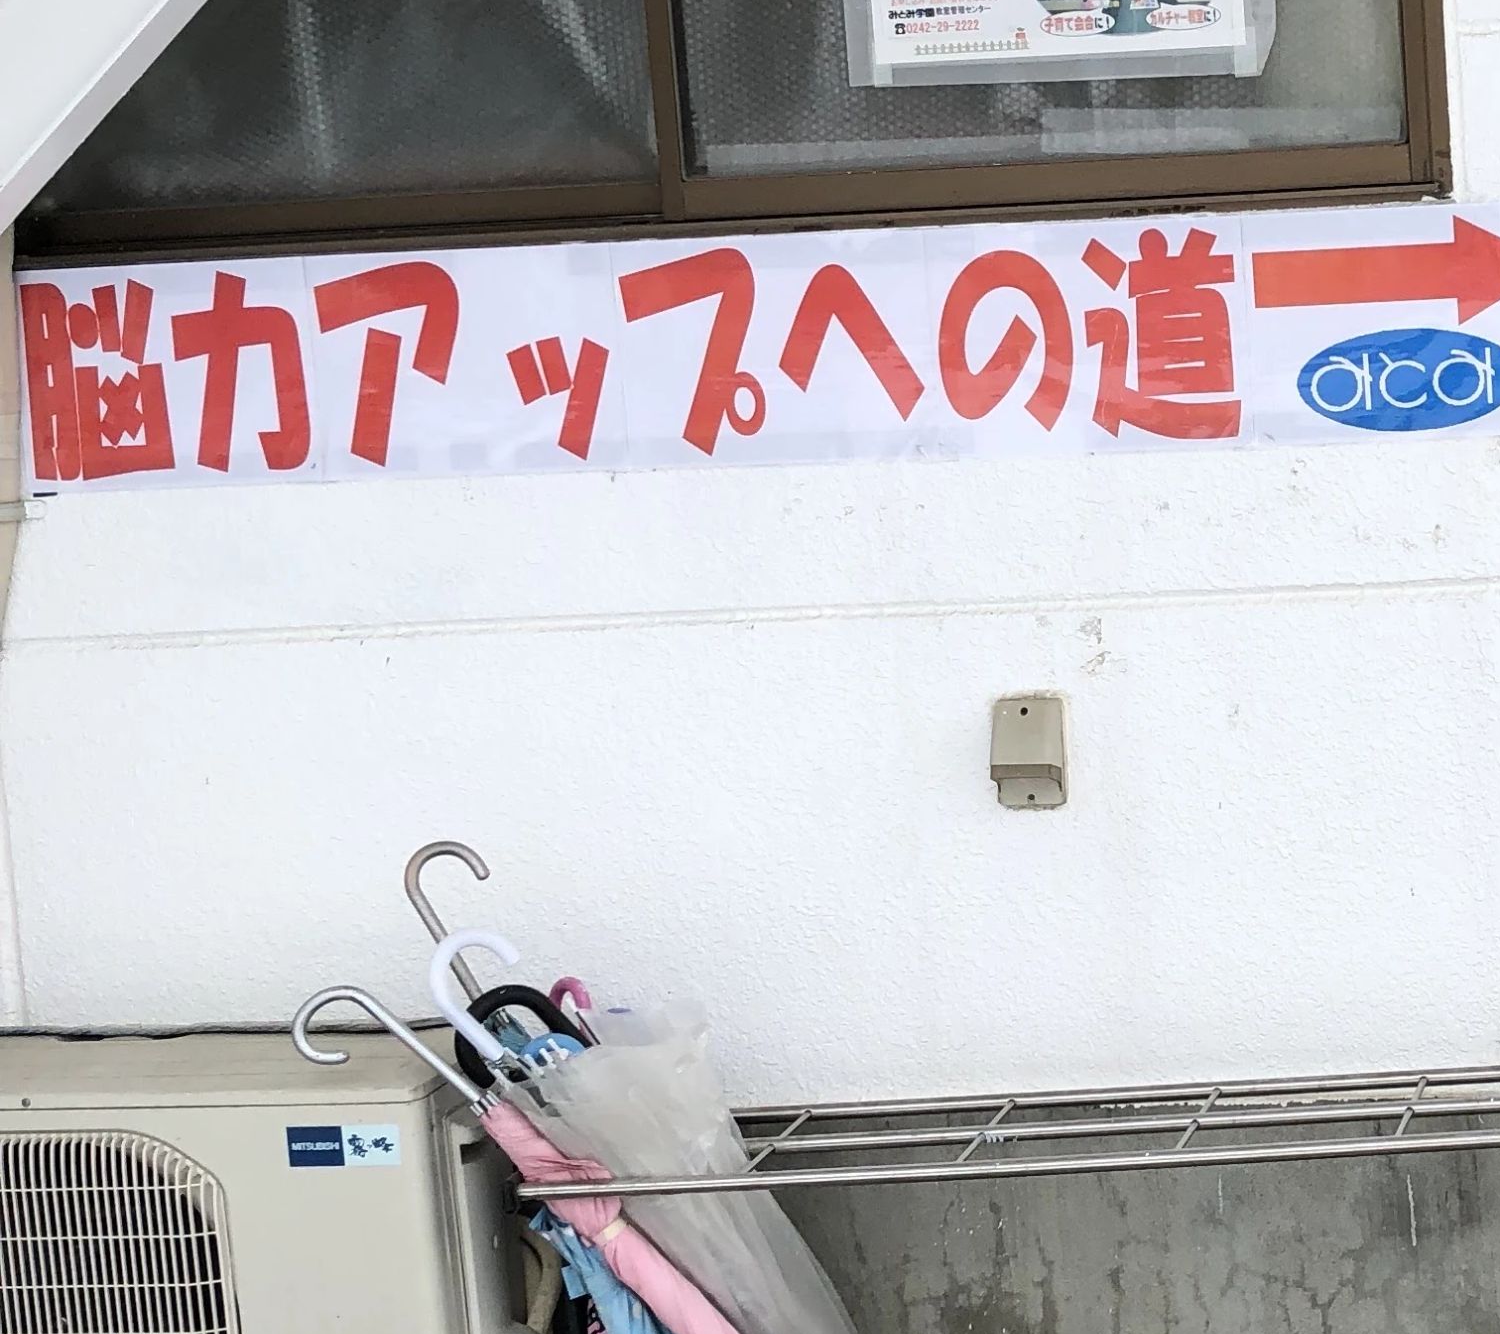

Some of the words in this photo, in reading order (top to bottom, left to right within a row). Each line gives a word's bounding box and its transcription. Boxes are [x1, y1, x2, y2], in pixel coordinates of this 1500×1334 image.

[1310, 347, 1496, 413] みとみ
[291, 1141, 340, 1151] MITSUBISHI
